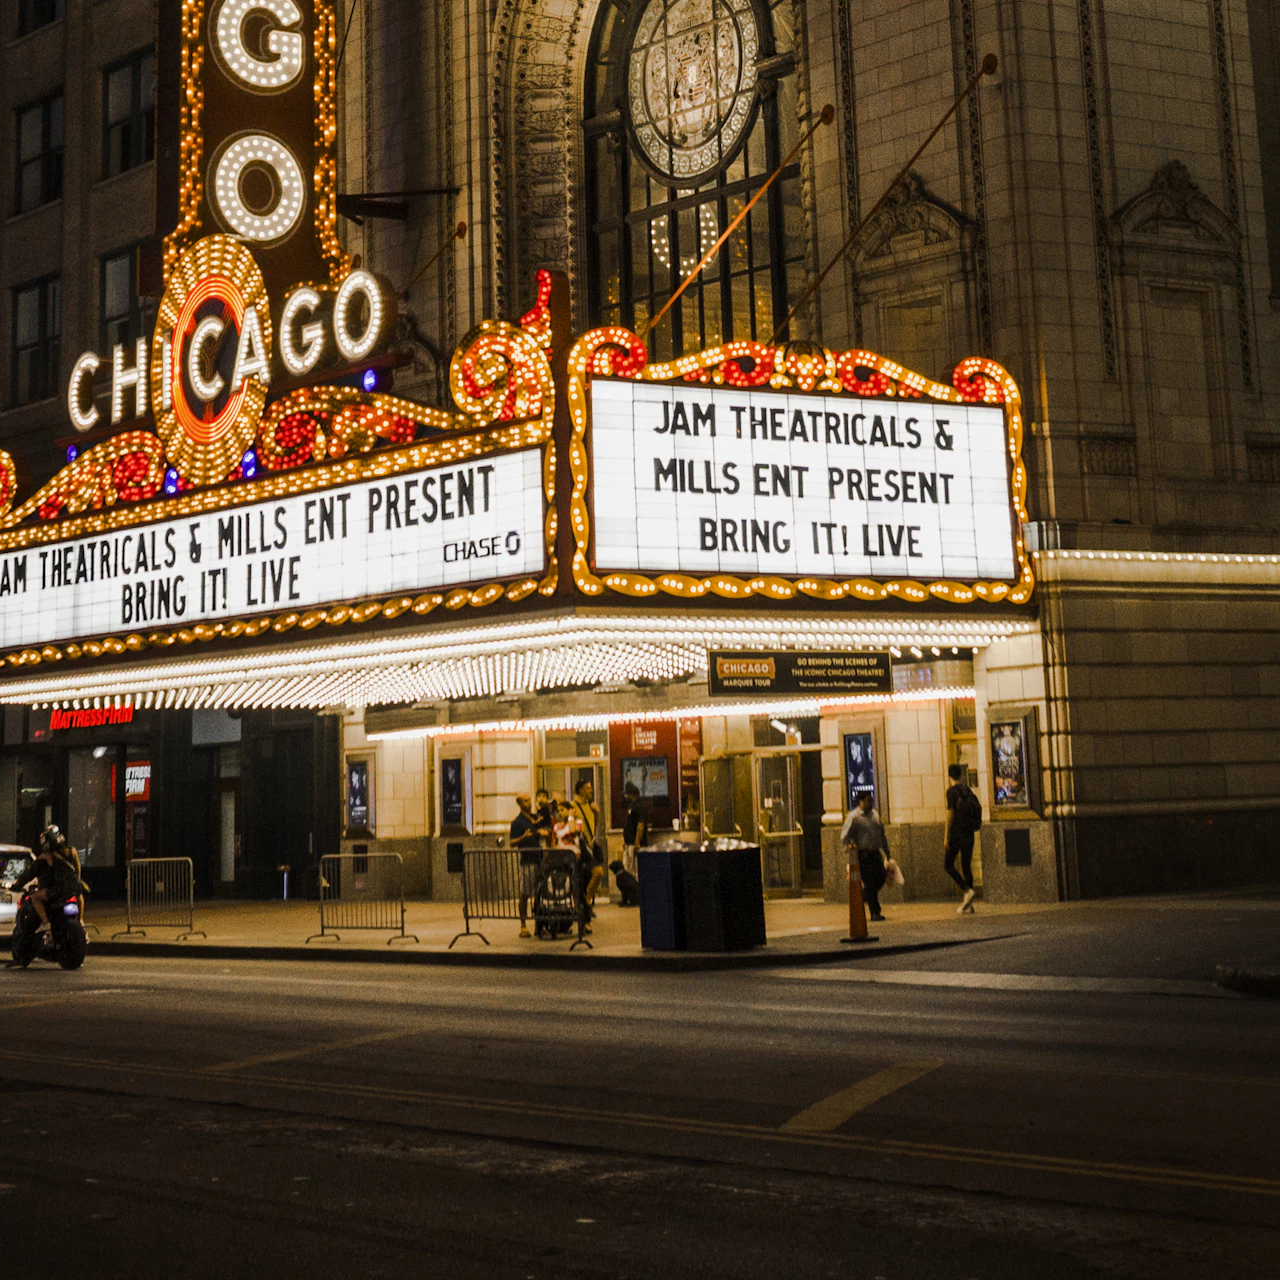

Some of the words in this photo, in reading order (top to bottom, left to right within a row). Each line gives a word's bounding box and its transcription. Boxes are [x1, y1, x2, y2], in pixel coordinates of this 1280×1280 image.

[67, 268, 384, 432] CHICAGO
[653, 400, 716, 437] JAM
[729, 405, 921, 448] THEATRICALS
[934, 419, 954, 451] &
[653, 457, 740, 496] MILLS
[754, 463, 809, 499] ENT
[828, 468, 954, 504] PRESENT
[39, 523, 176, 590] THEATRICALS
[188, 524, 202, 564] &
[219, 506, 288, 559] MILLS
[305, 493, 351, 545] ENT
[368, 465, 494, 534] PRESENT
[699, 517, 791, 554] BRING
[811, 521, 849, 556] IT!
[862, 523, 923, 558] LIVE
[443, 534, 501, 563] CHASE
[121, 575, 186, 624] BRING
[200, 569, 227, 613] IT!
[246, 555, 301, 606] LIVE
[723, 663, 769, 674] CHICAGO
[791, 668, 803, 677] THE
[804, 668, 826, 677] ICONIC
[827, 668, 855, 677] CHICAGO
[856, 668, 884, 677] THEATRE!
[797, 658, 807, 666] GO
[808, 657, 832, 666] BEHIND
[832, 658, 844, 666] THE
[845, 658, 868, 666] SCENES
[869, 657, 878, 666] OF
[723, 678, 753, 687] MARQUEE
[754, 679, 770, 687] TOUR
[125, 779, 145, 793] FIRM
